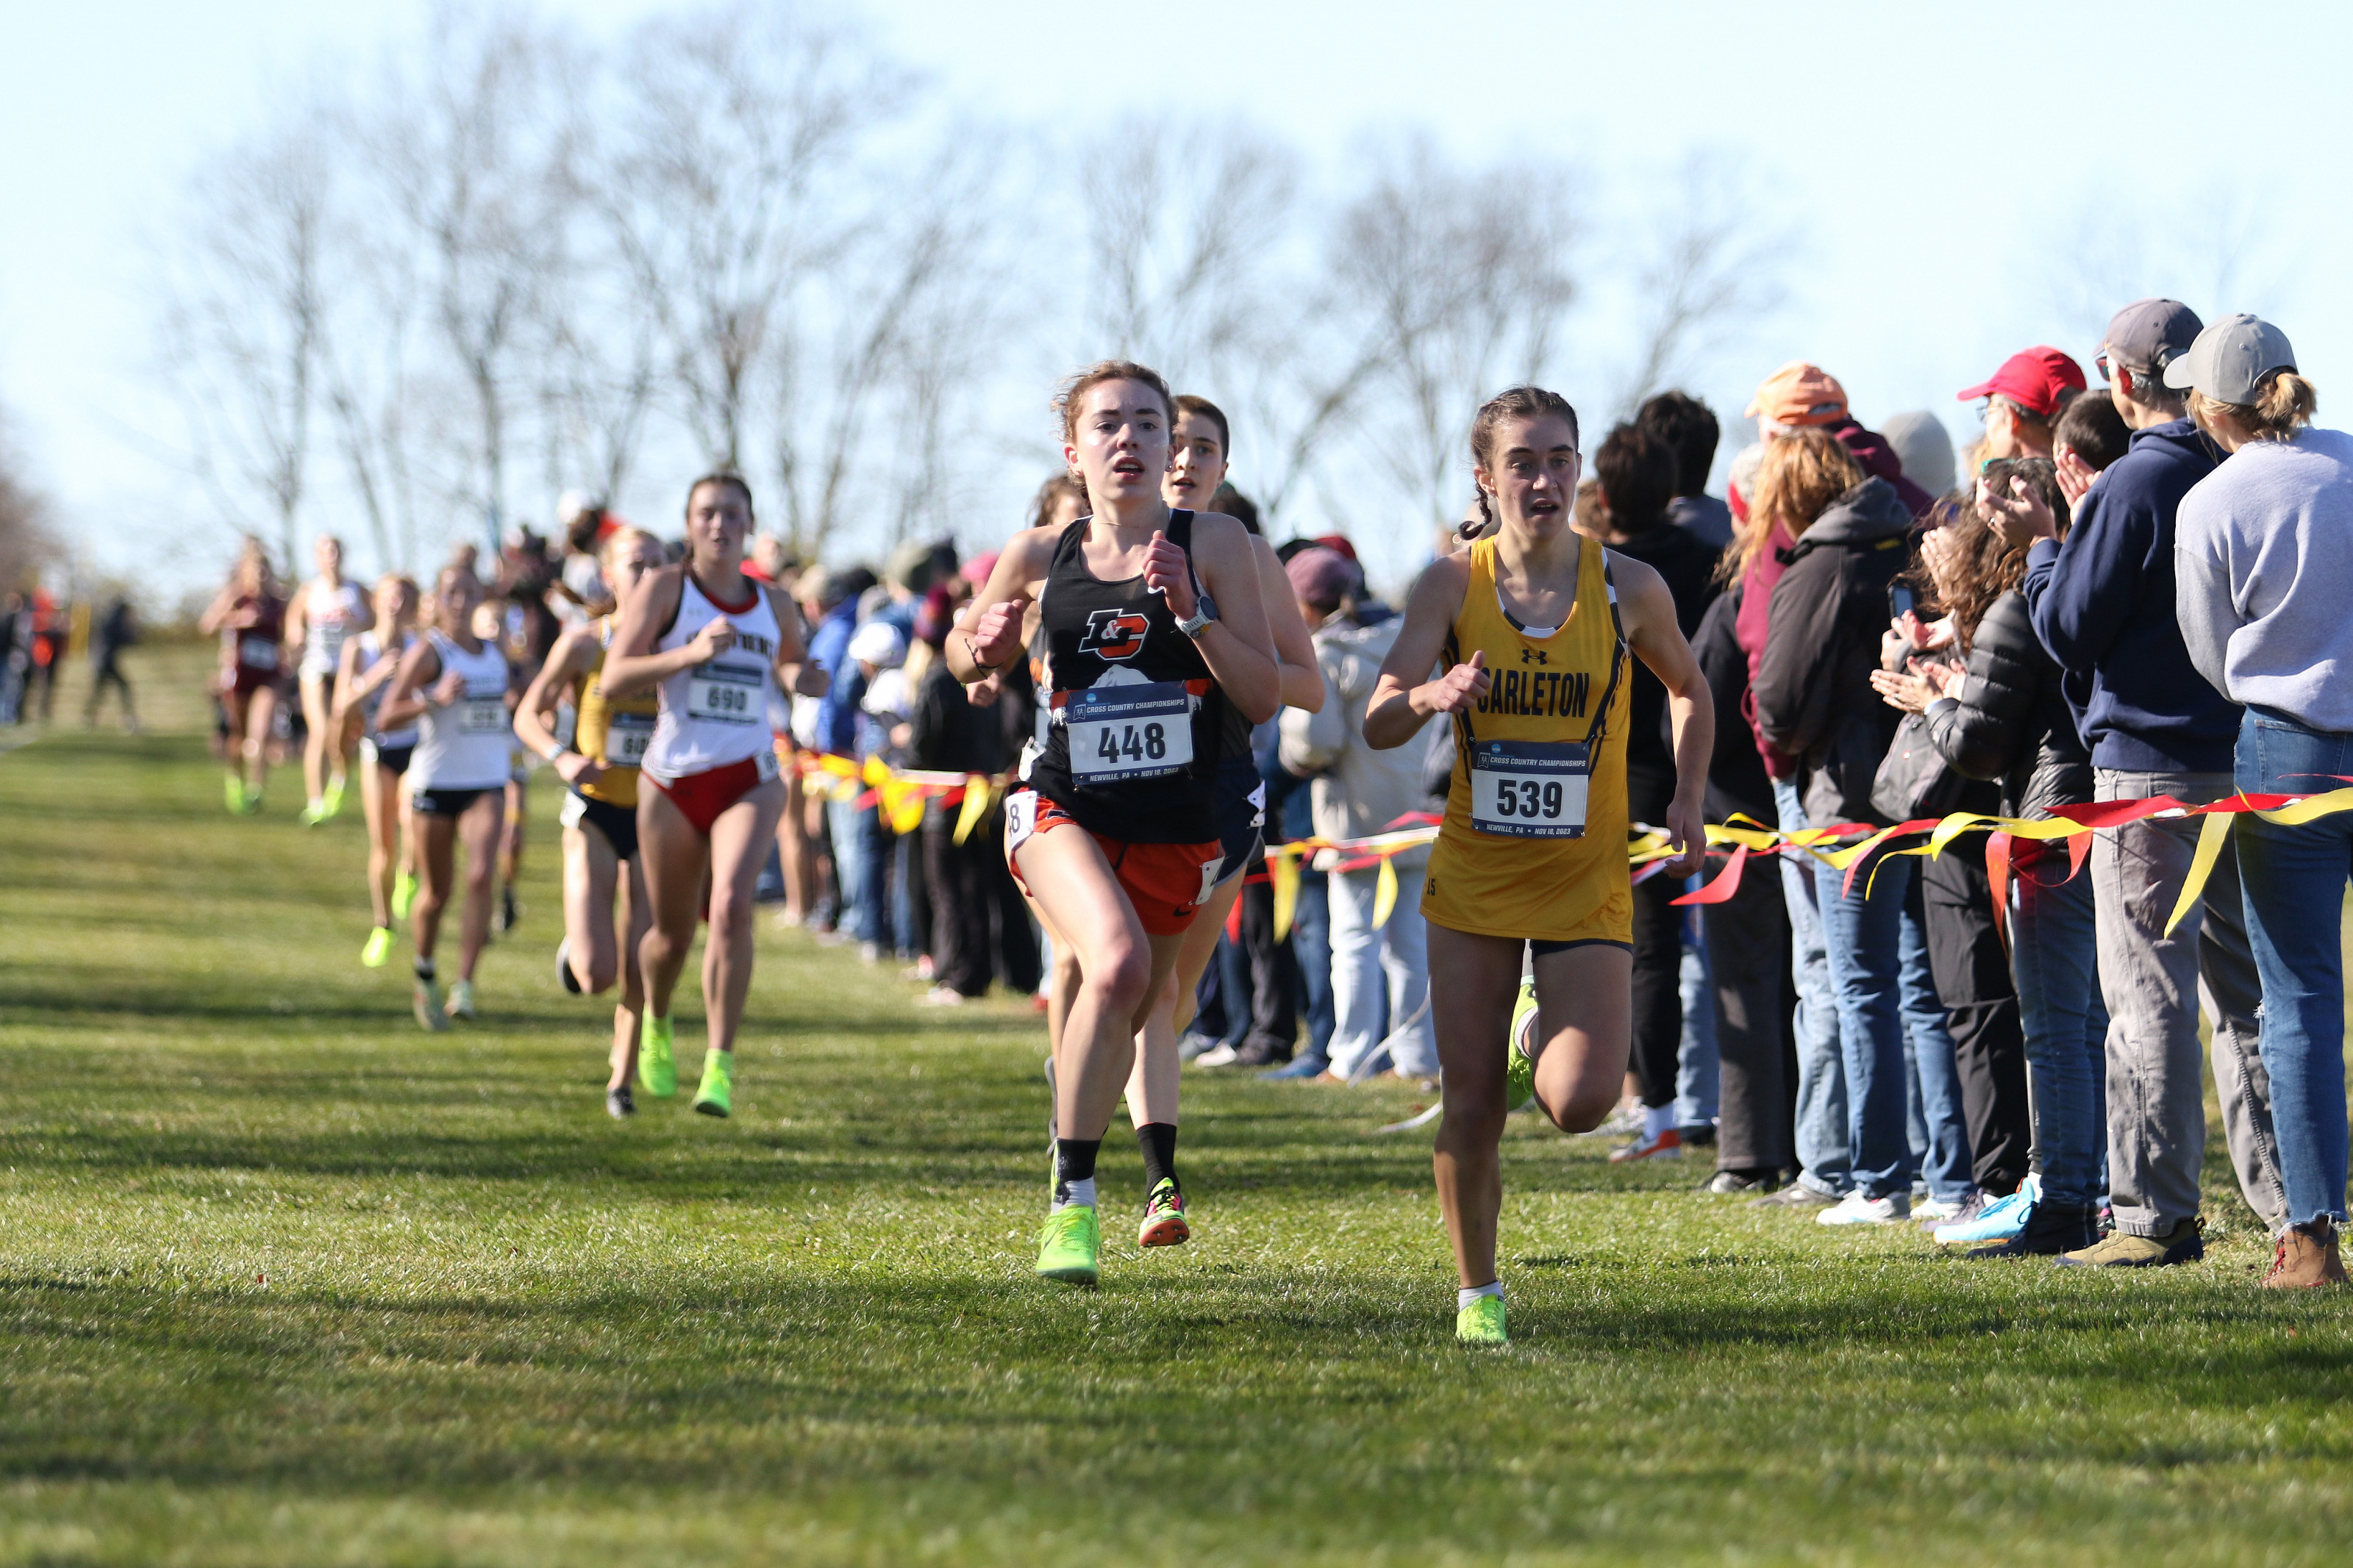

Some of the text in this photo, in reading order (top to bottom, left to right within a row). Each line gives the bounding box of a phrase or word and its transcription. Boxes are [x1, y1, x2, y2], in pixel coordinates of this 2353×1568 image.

[707, 686, 747, 712] 690
[1086, 704, 1107, 714] CROSS
[1107, 701, 1135, 712] COUNTRY
[1135, 698, 1185, 709] CHAMPIONSHIPS
[1098, 722, 1166, 764] 448
[1490, 756, 1510, 765] CROSS
[1510, 758, 1538, 766] COUNTRY
[1090, 773, 1119, 782] NEWVILLE,
[1496, 779, 1563, 819] 539
[1007, 803, 1021, 834] 8
[1486, 823, 1513, 834] NEWVILLE,
